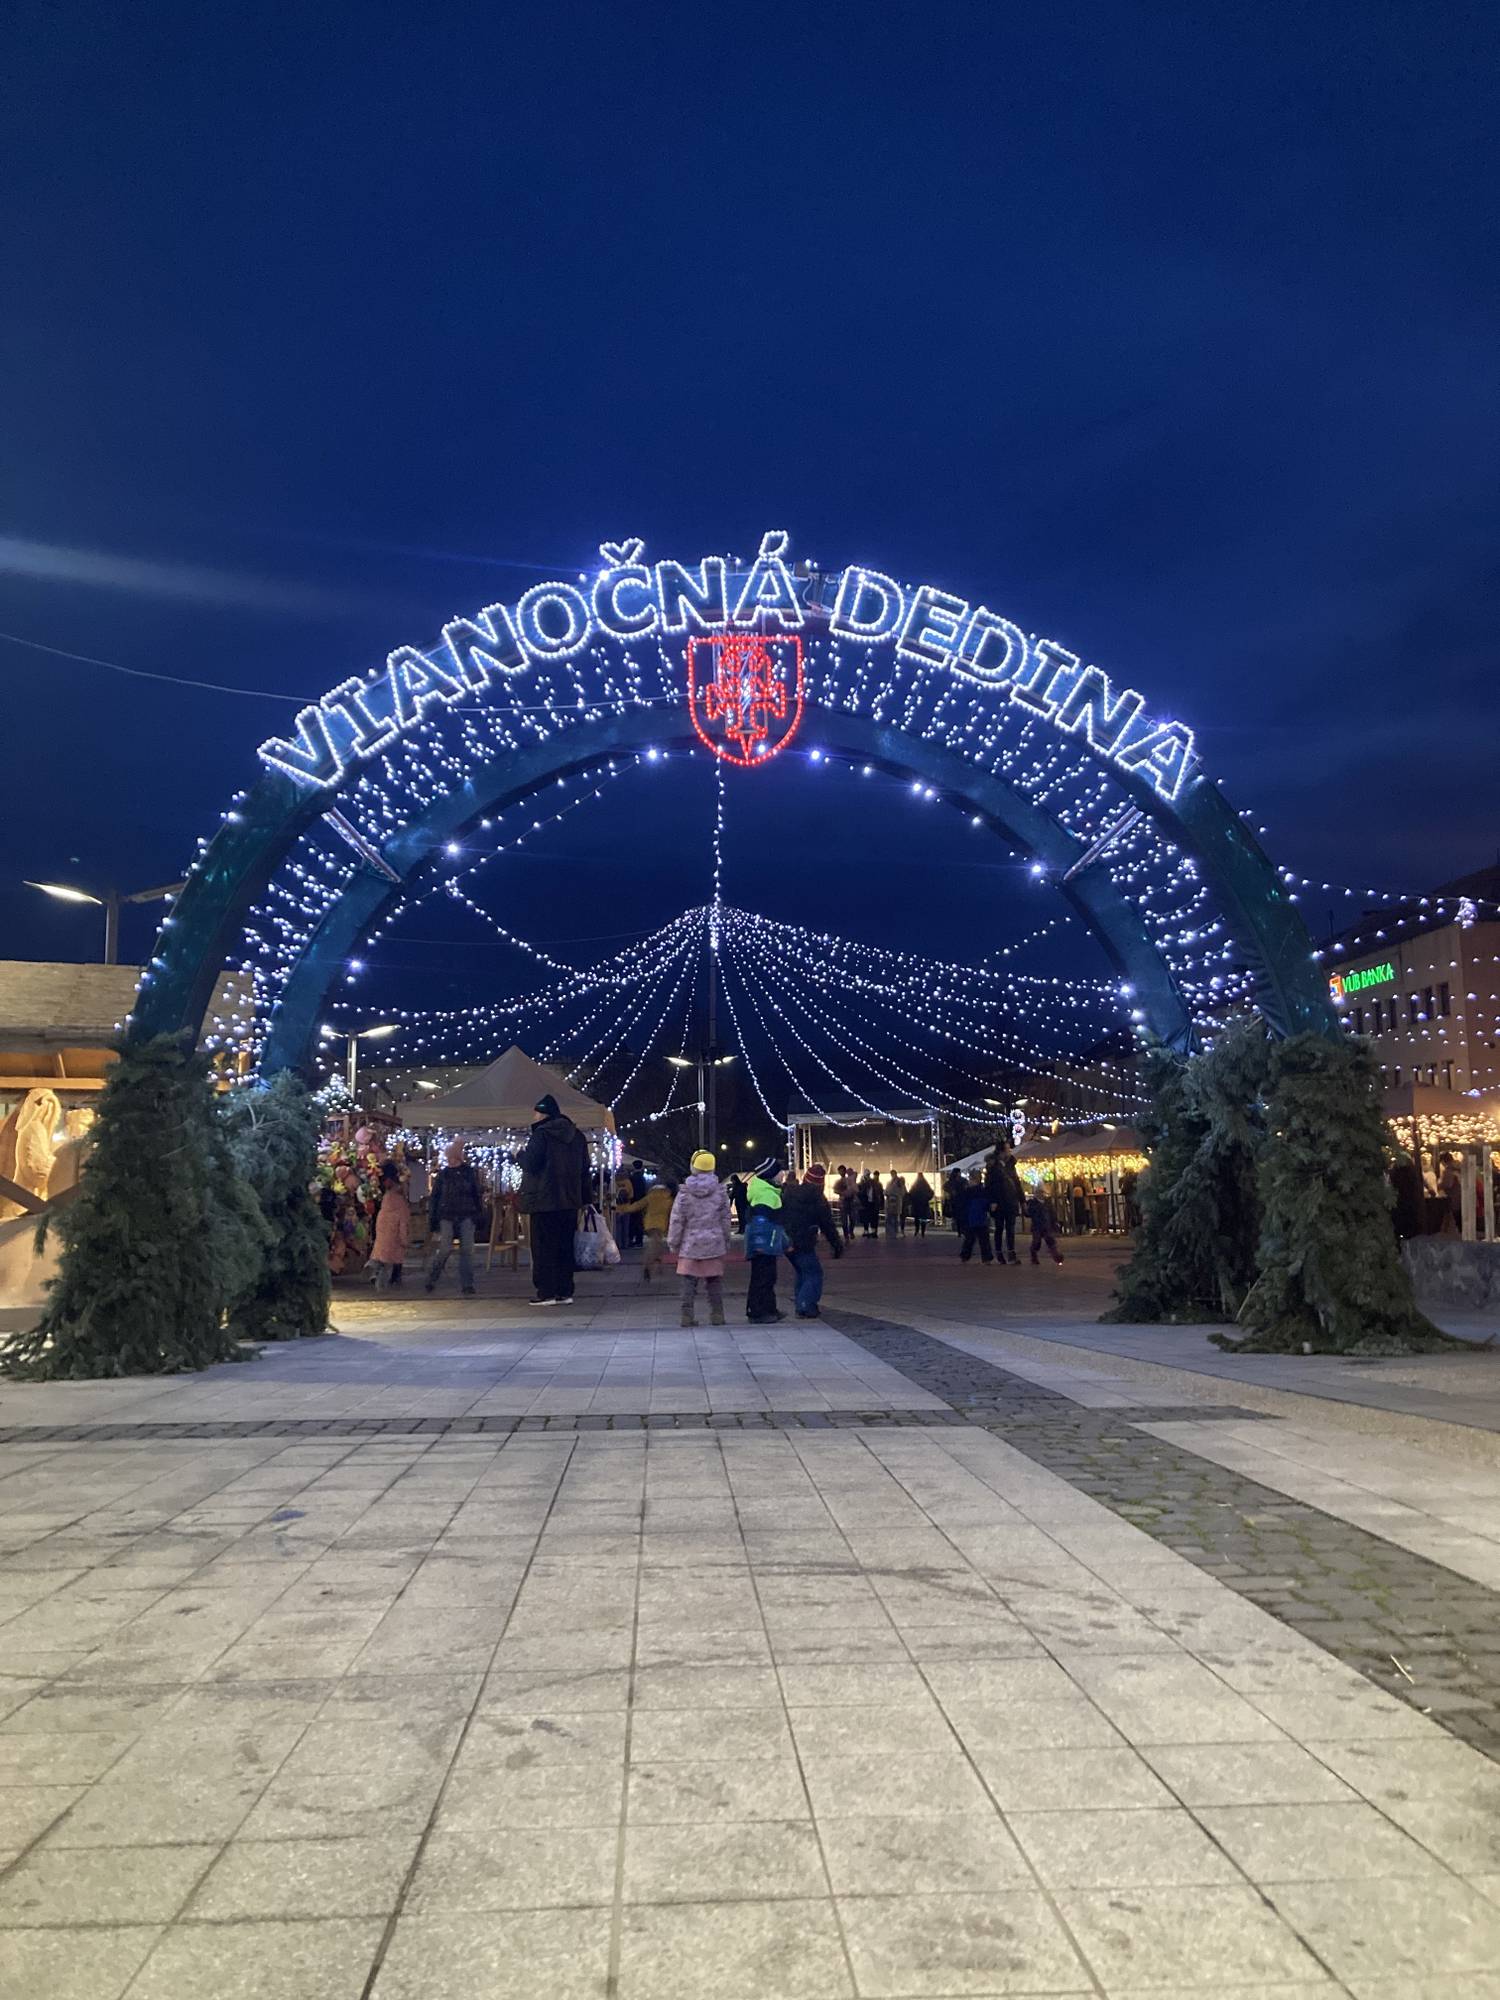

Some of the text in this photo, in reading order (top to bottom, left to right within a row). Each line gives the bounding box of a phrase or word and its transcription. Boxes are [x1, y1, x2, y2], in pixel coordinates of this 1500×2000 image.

[256, 530, 1195, 801] VIANOČNÁ DEDINA
[1361, 962, 1394, 988] BANKA
